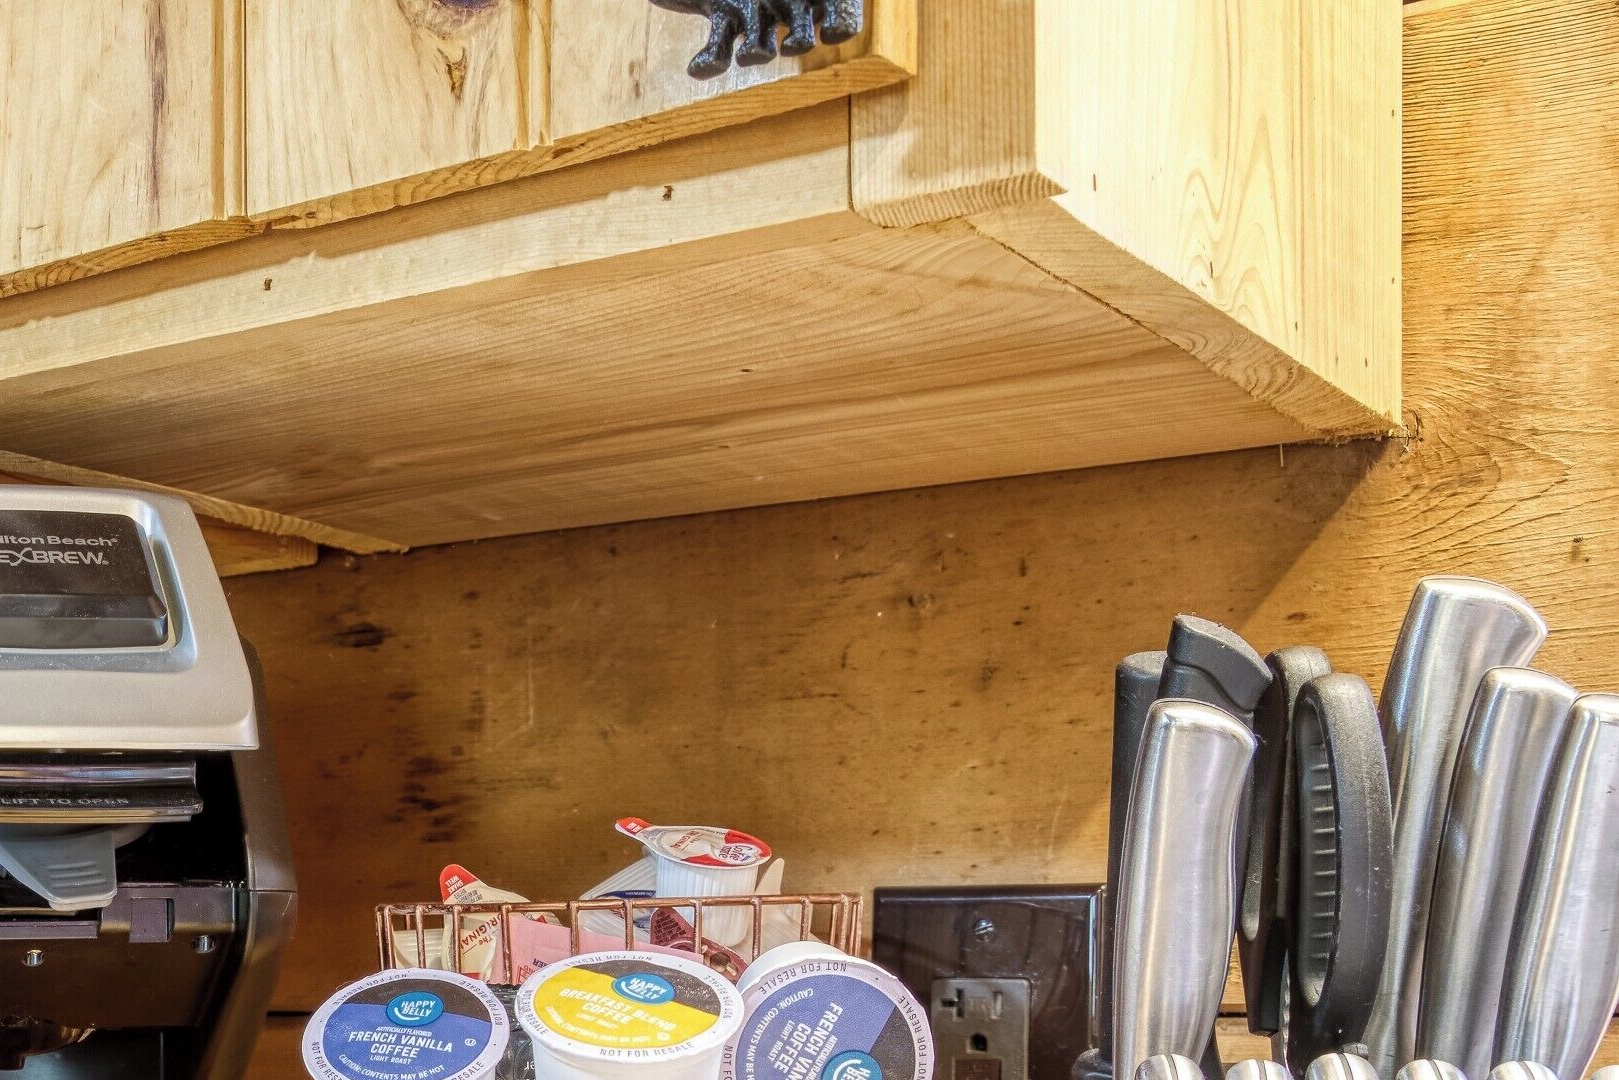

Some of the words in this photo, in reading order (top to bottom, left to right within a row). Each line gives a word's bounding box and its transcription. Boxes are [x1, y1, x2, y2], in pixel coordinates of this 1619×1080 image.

[478, 935, 493, 946] The
[801, 962, 823, 974] FOR
[826, 961, 848, 972] NOT
[631, 977, 667, 994] HAPPY
[759, 969, 798, 995] RESALE
[401, 1000, 436, 1009] HAPPY
[779, 987, 815, 1011] CAUTION:
[401, 1007, 433, 1017] BELLY
[559, 988, 633, 1012] BREAKFAST
[632, 1010, 677, 1032] BLEND
[582, 1003, 633, 1025] COFFEE
[899, 995, 926, 1034] RESALE
[750, 1006, 779, 1045] CONTENTS
[781, 1020, 795, 1040] LIGHT
[804, 1002, 844, 1056] FRENCH
[311, 1041, 320, 1057] NOT
[348, 1031, 398, 1043] FRENCH
[401, 1035, 453, 1053] VANILLA
[370, 1043, 420, 1058] COFFEE
[600, 1048, 621, 1058] NOT
[627, 1049, 651, 1058] FOR
[654, 1041, 693, 1056] RESALE
[768, 1040, 784, 1062] ROAST
[774, 1022, 812, 1074] COFFEE
[918, 1036, 929, 1060] FOR
[390, 1057, 412, 1065] ROAST
[746, 1045, 757, 1059] MAY
[314, 1055, 325, 1071] FOR
[339, 1054, 361, 1073] CAUTION:
[361, 1068, 399, 1080] CONTENTS
[400, 1073, 417, 1080] MAY
[418, 1070, 429, 1079] BE
[428, 1064, 445, 1076] HOT
[746, 1062, 755, 1074] BE
